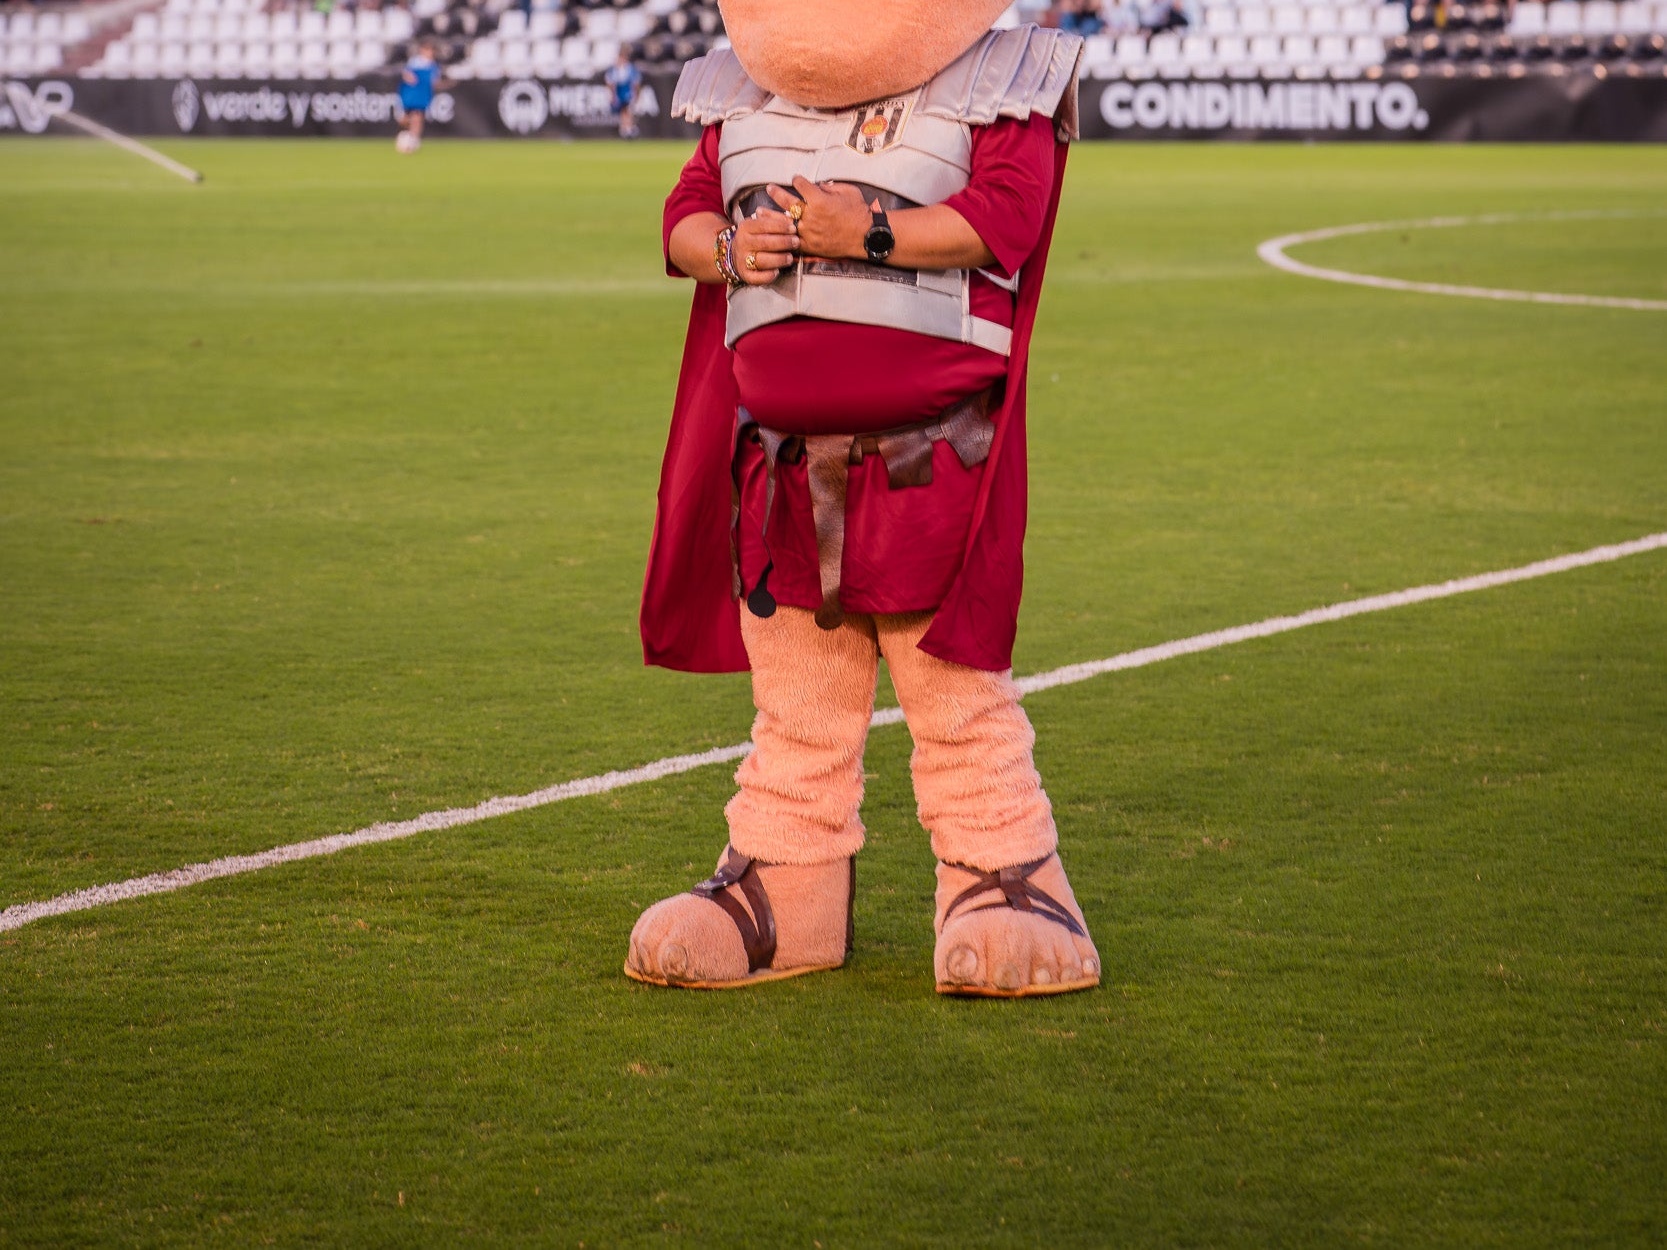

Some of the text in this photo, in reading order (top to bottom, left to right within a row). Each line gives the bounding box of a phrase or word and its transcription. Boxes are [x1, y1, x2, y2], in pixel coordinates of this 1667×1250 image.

[203, 85, 287, 122] verde
[287, 91, 310, 128] y
[1101, 82, 1429, 130] CONDIMENTO.
